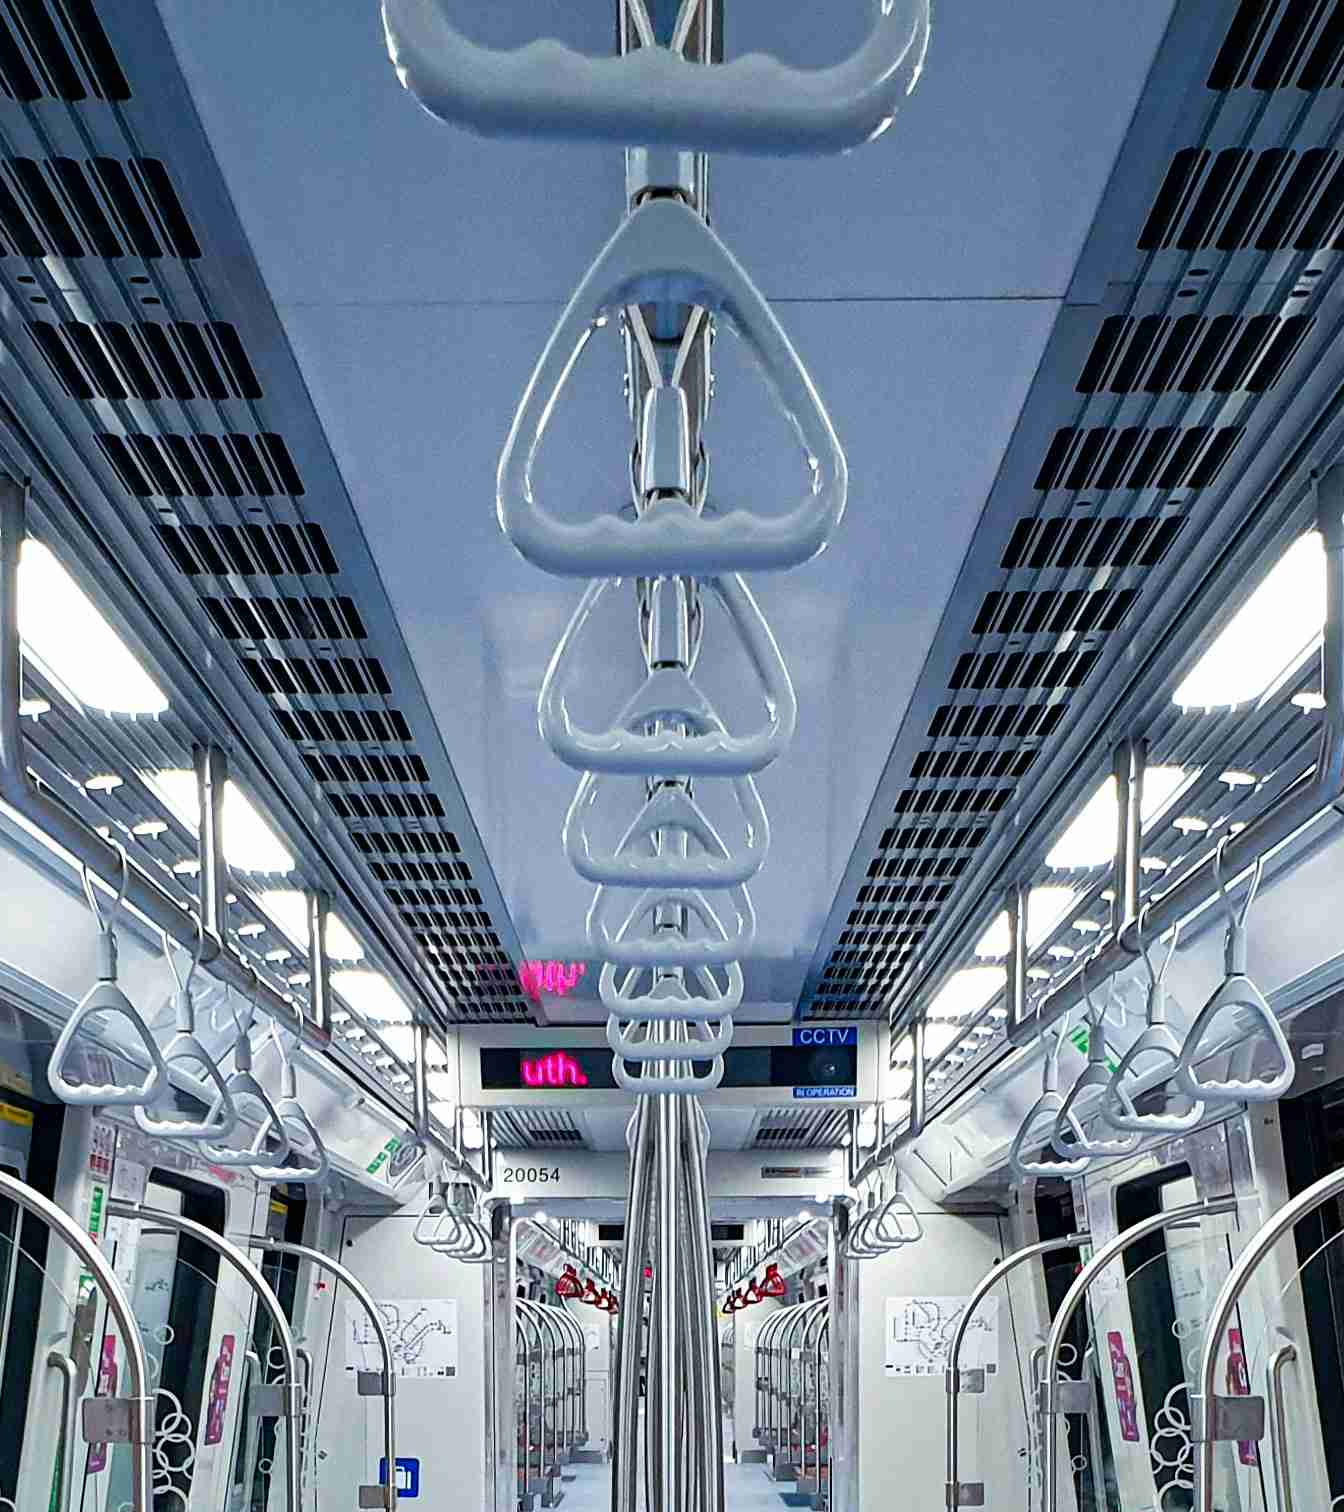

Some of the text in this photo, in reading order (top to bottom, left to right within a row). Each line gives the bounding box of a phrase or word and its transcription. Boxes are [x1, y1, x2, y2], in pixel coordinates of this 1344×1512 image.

[799, 1028, 849, 1044] CCTV
[806, 1087, 854, 1097] OPERATION
[503, 1167, 561, 1183] 20054
